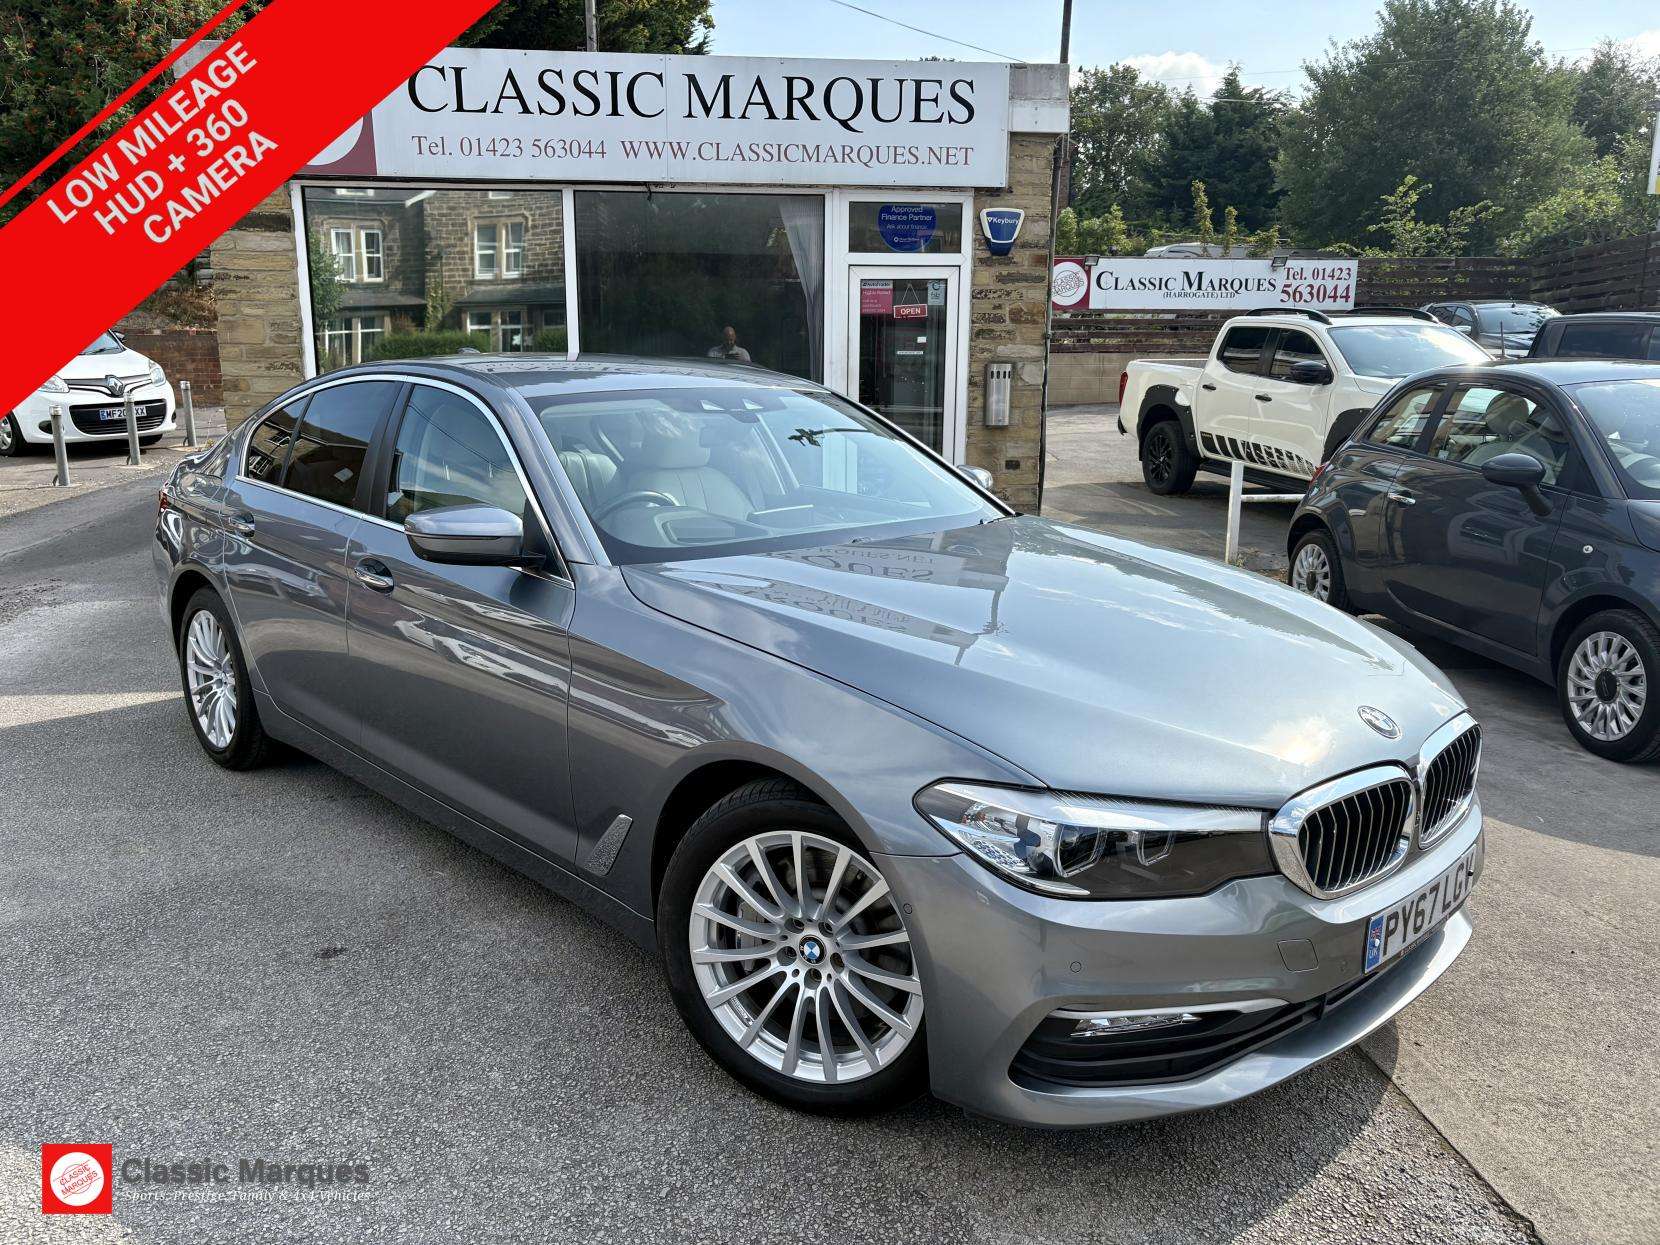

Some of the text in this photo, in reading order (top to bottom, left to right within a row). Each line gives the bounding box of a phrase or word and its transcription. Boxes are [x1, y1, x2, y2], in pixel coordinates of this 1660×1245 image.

[408, 64, 975, 134] CLASSIC MARQUES
[411, 135, 975, 169] Tel. 01423 563044 WWW.CLASSICMARQUES.NET
[891, 205, 923, 213] Approved
[881, 213, 933, 221] Finance Partner
[993, 216, 1019, 225] Keybury
[1283, 266, 1352, 281] Tel. 01423
[1162, 291, 1236, 299] (HARROGATE) LTD
[1279, 283, 1351, 303] 563044
[900, 307, 921, 315] OPEN
[1382, 882, 1441, 957] PY67
